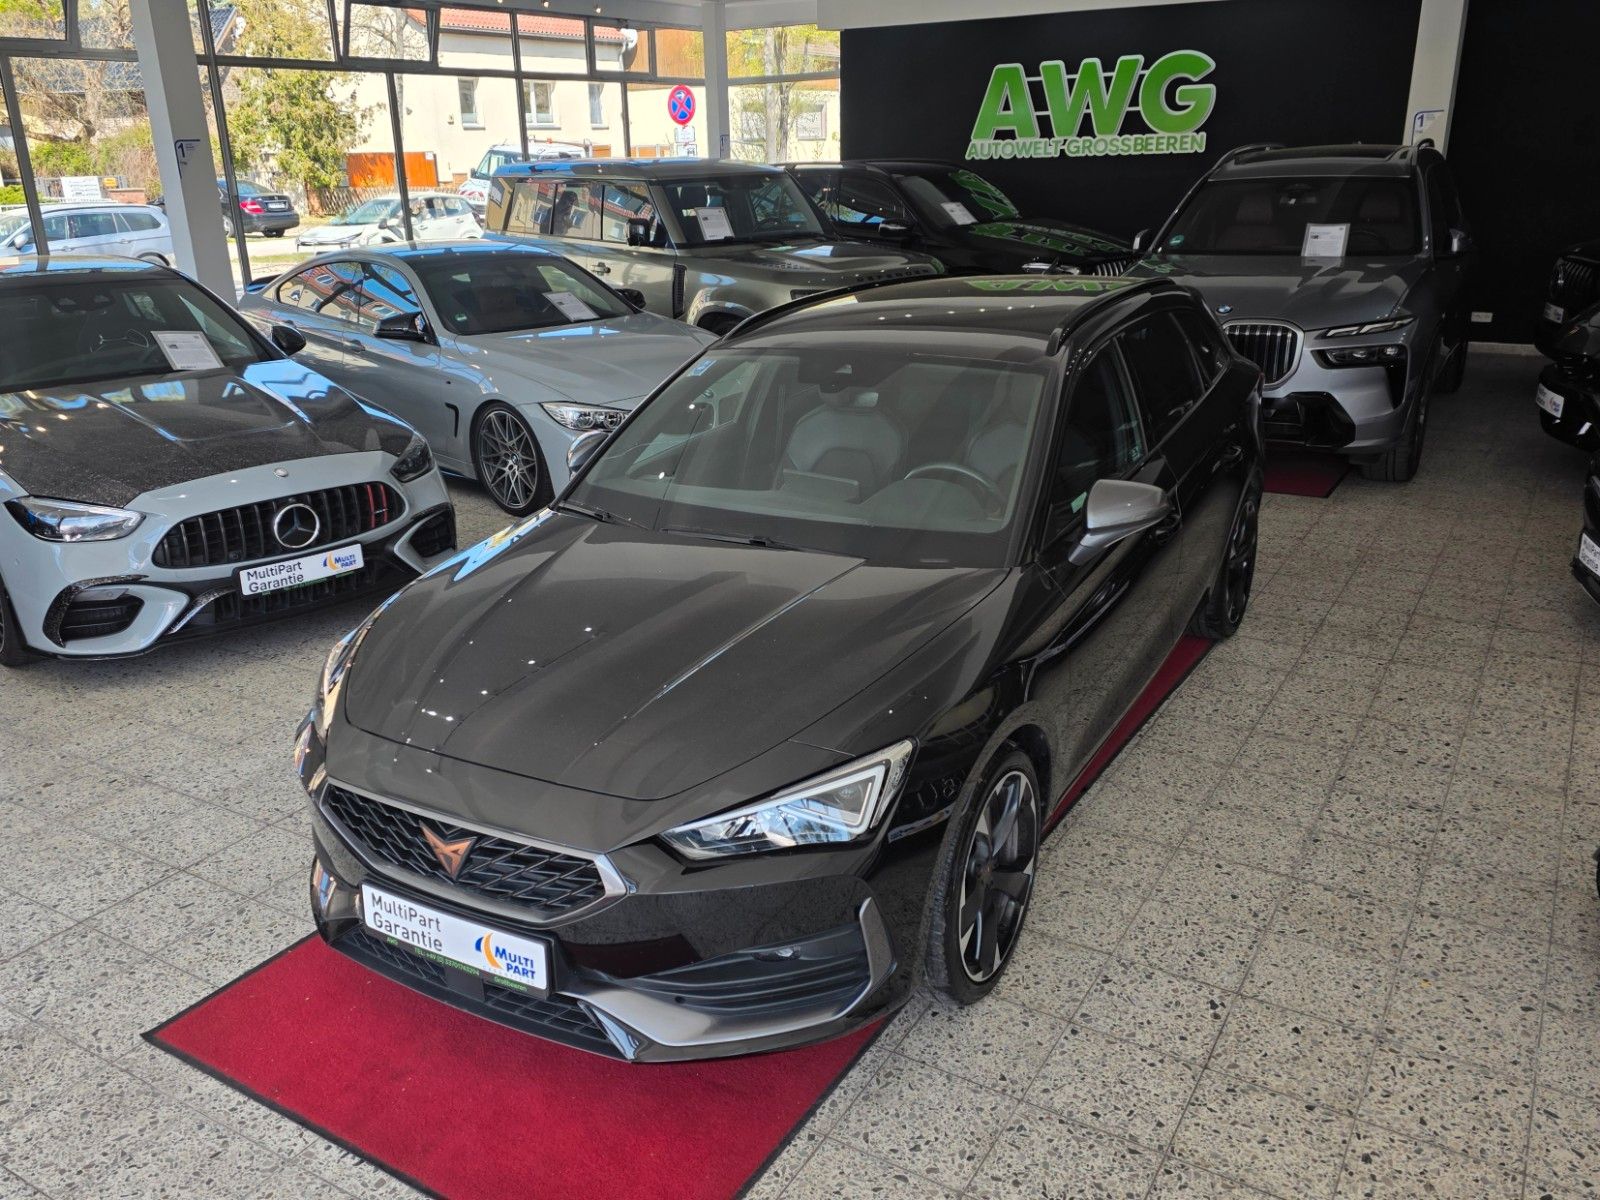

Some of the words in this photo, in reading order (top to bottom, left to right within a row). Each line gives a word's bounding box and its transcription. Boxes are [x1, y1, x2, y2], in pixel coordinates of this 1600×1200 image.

[971, 50, 1217, 140] AWG
[965, 138, 1063, 159] AUTOWELT
[1064, 132, 1206, 157] GROSSBEEREN
[246, 561, 303, 582] MultiPart
[248, 573, 304, 592] Garantie
[371, 892, 442, 932] MultiPart
[373, 911, 443, 952] Garantie
[494, 945, 534, 969] MULTI
[506, 962, 536, 980] PART
